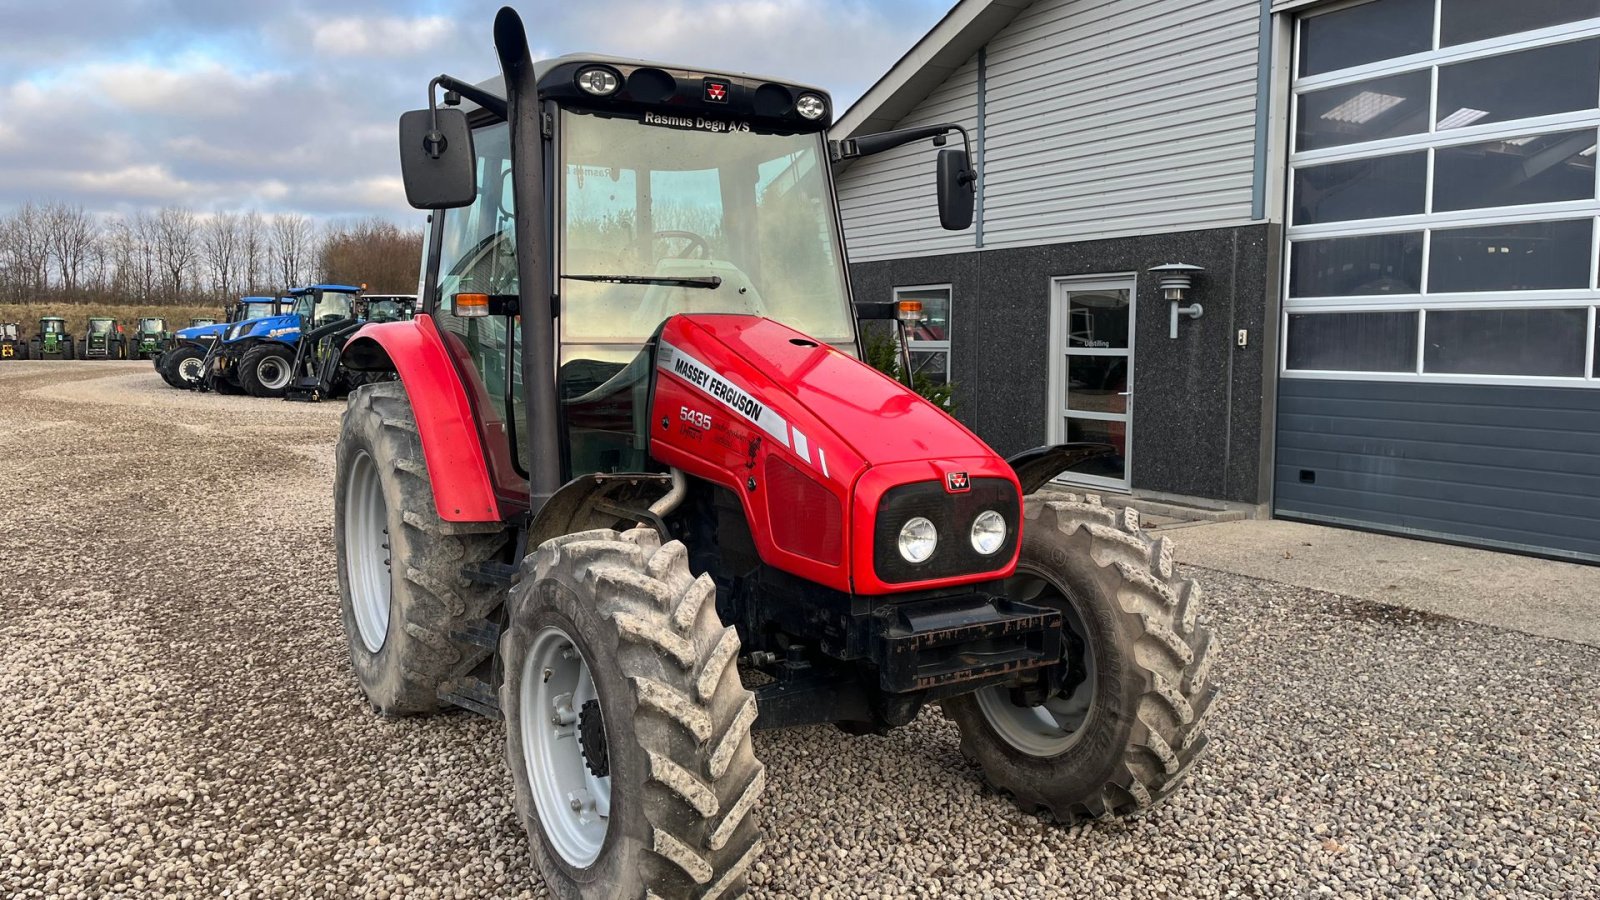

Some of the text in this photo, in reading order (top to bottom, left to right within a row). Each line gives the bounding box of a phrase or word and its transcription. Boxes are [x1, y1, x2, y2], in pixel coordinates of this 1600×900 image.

[644, 111, 750, 133] Rasmus Degn A/S
[674, 358, 763, 422] MASSEY FERGUSON
[679, 406, 712, 431] 5435
